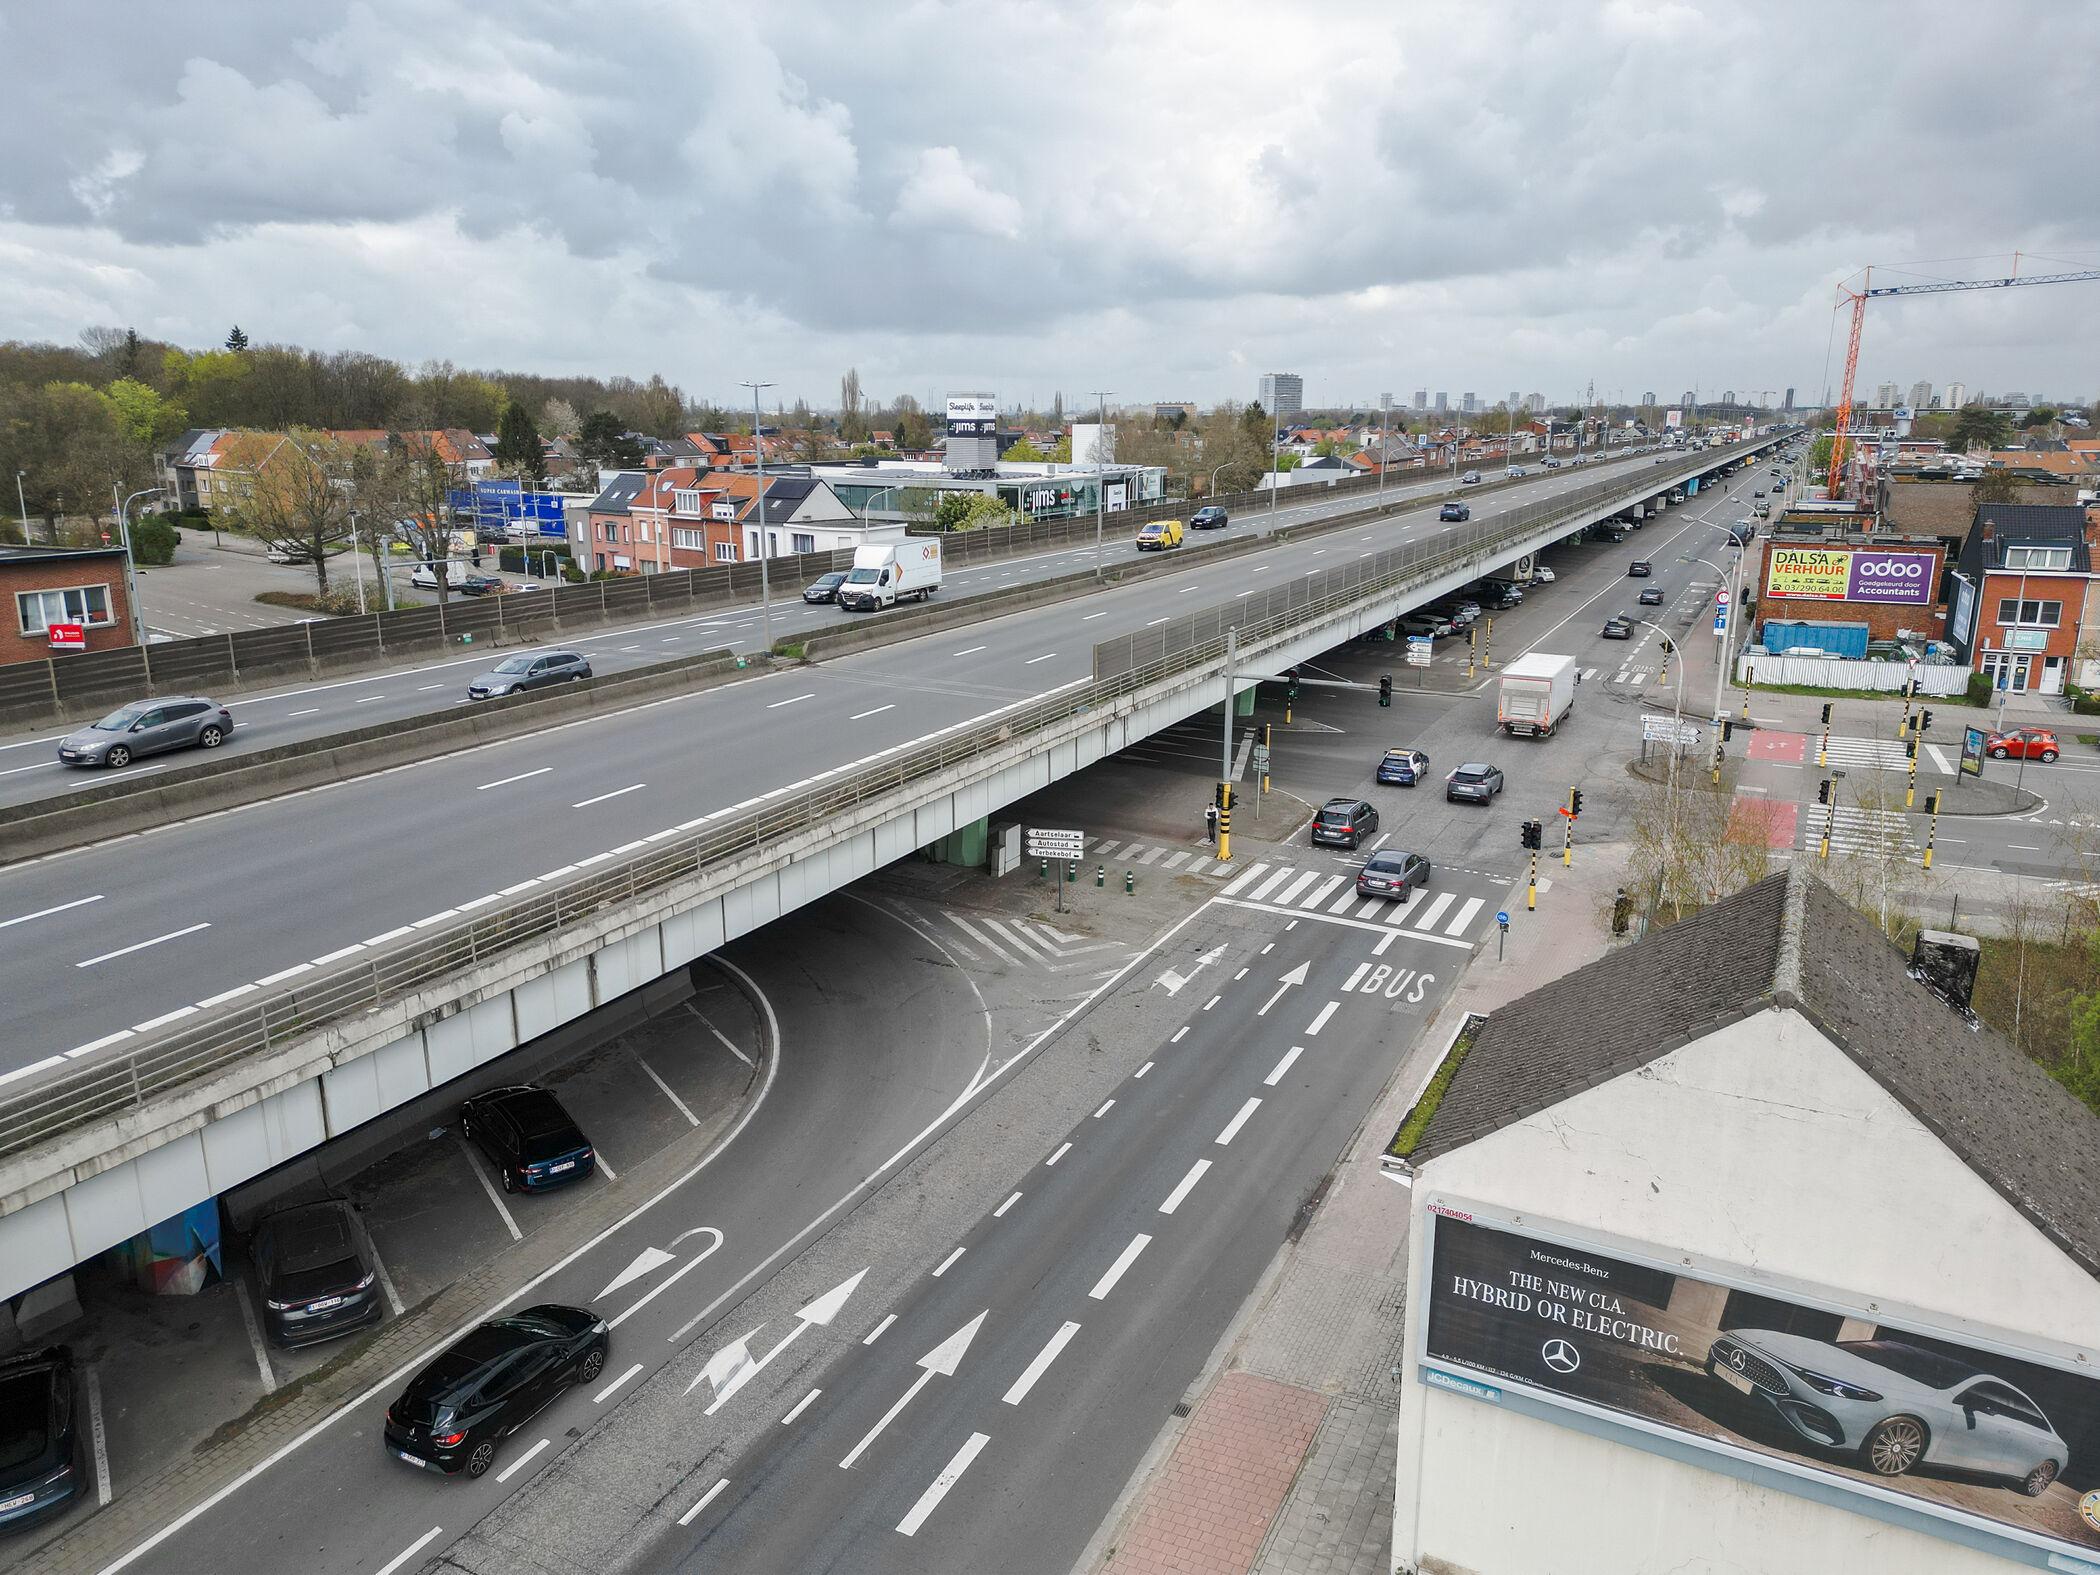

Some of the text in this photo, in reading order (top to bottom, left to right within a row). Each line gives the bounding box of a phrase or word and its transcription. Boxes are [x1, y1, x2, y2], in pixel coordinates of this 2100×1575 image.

[955, 422, 976, 434] jims
[1032, 489, 1056, 514] jims
[1776, 552, 1829, 565] DALSA
[1775, 564, 1845, 576] VERHUUR
[1859, 559, 1922, 577] odoo
[1784, 585, 1844, 593] 03/290.64.00
[1858, 579, 1903, 588] Goedgekeurd
[1858, 587, 1920, 597] Accountants
[1035, 830, 1072, 838] Aartselaar
[1360, 963, 1435, 1003] BUS
[1427, 1204, 1473, 1222] 0217404054
[1530, 1250, 1609, 1279] Mercedes-Benz
[1509, 1270, 1626, 1316] THE NEW CLA.
[1452, 1275, 1684, 1356] HYBRID OR ELECTRIC.
[1427, 1372, 1482, 1395] JCDecaux
